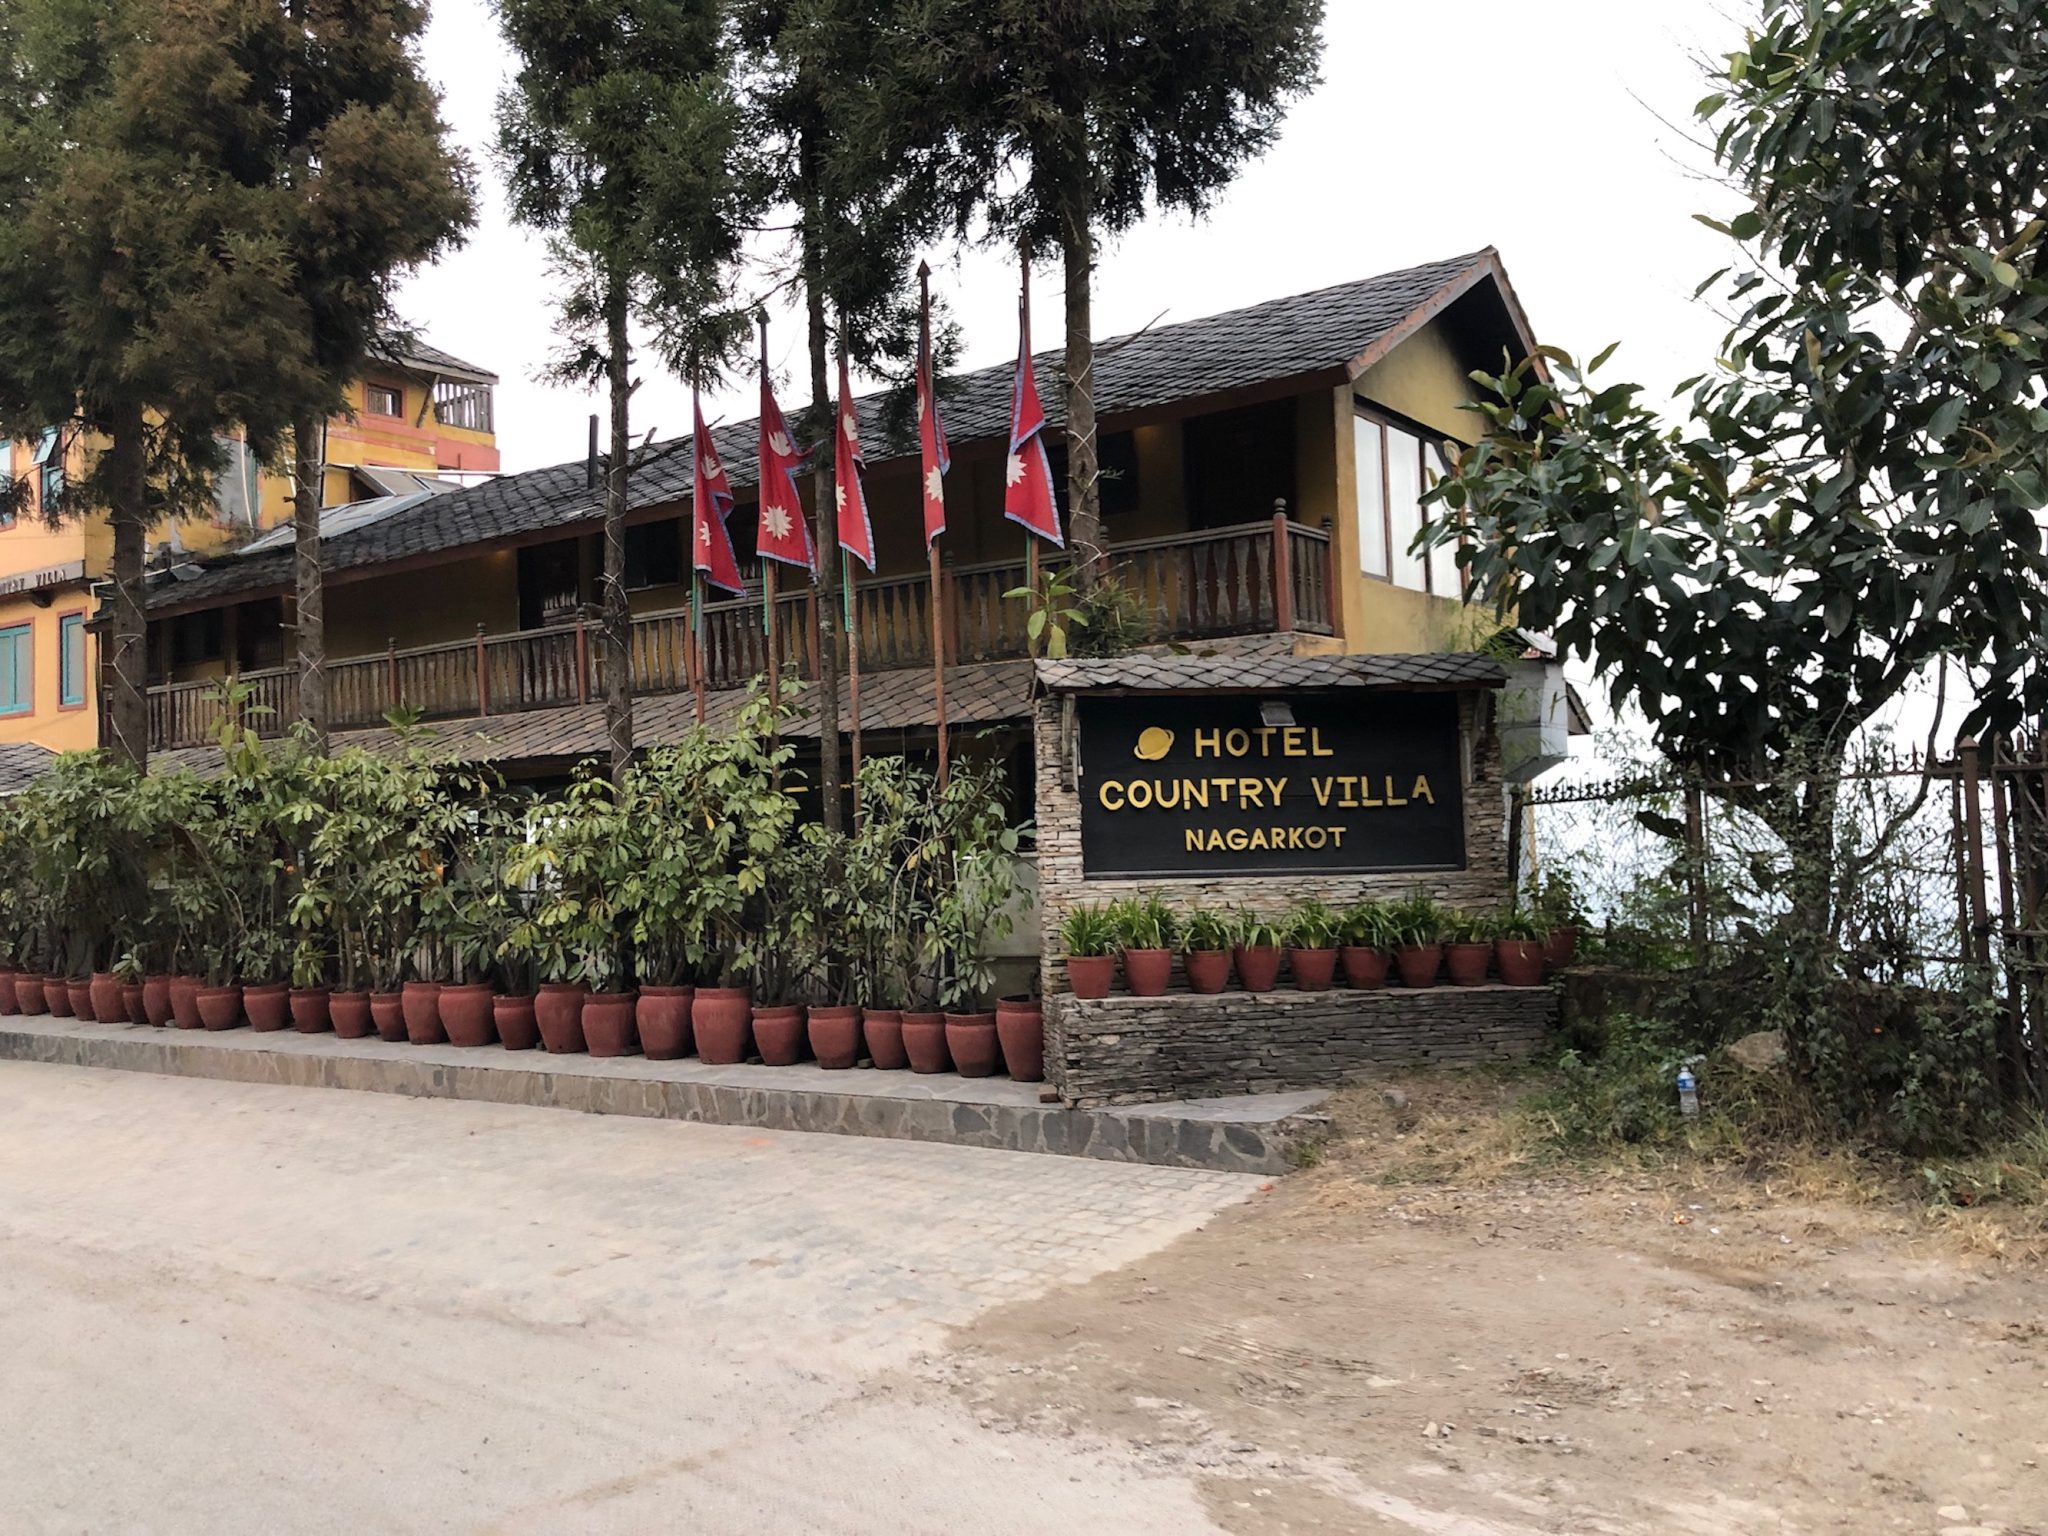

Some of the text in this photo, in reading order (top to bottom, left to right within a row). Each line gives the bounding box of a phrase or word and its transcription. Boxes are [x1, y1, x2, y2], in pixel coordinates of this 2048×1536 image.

[35, 569, 66, 588] VILLA
[1195, 727, 1333, 757] HOTEL
[1100, 774, 1434, 811] COUNTRY VILLA
[1186, 827, 1346, 851] NAGARKOT
